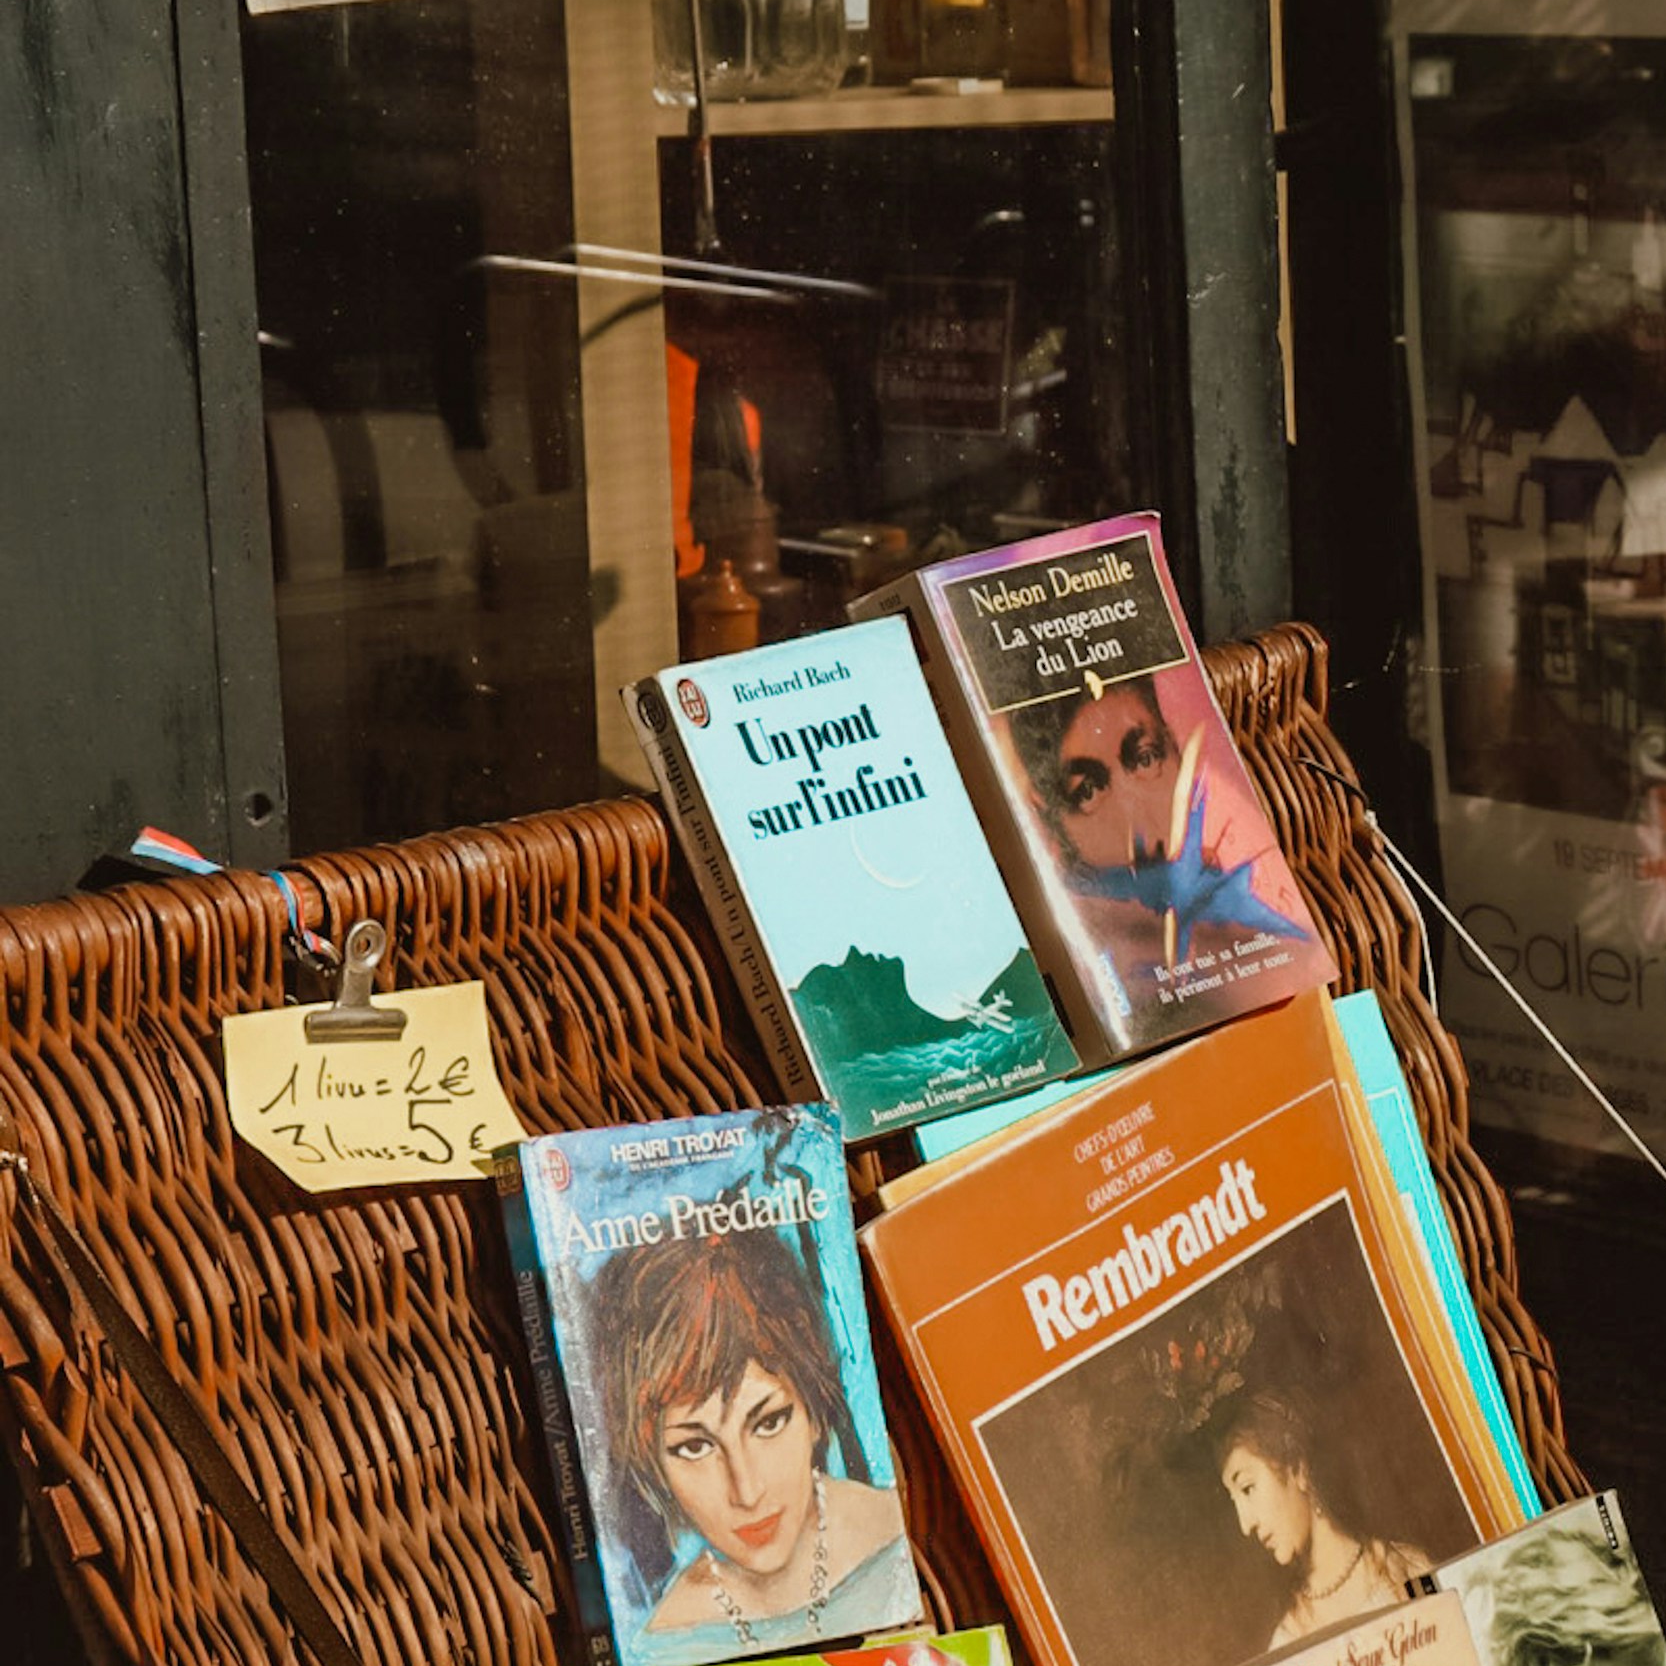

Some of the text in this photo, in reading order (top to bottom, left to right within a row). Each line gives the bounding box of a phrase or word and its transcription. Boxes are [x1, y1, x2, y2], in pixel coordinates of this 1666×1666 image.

[968, 551, 1135, 617] Nelson Demille
[991, 596, 1139, 652] La vengeance
[1035, 634, 1124, 677] du Lion
[731, 661, 852, 705] Richard Bach
[734, 703, 881, 773] Un pont
[659, 744, 807, 1089] Richard pont sur l'infini
[1174, 974, 1224, 1003] périront
[1235, 961, 1262, 979] leur
[1195, 950, 1218, 969] tué
[1220, 948, 1234, 962] sa
[258, 1063, 299, 1114] 1
[403, 1045, 432, 1096] 2
[440, 1055, 475, 1097] €
[870, 1101, 925, 1125] Jonathan
[924, 1077, 987, 1107] Livingston
[986, 1074, 999, 1089] le
[271, 1123, 326, 1164] 3
[407, 1099, 455, 1165] 5
[468, 1123, 495, 1154] €
[610, 1126, 748, 1165] HENRI TROYAT
[1099, 1133, 1146, 1176] DE L'ART
[1085, 1145, 1176, 1214] GRANDS PEINTRES
[563, 1178, 831, 1256] Anne Prédaille
[1021, 1158, 1268, 1353] Rembrandt
[516, 1270, 587, 1562] Henri Troyat Prédaille
